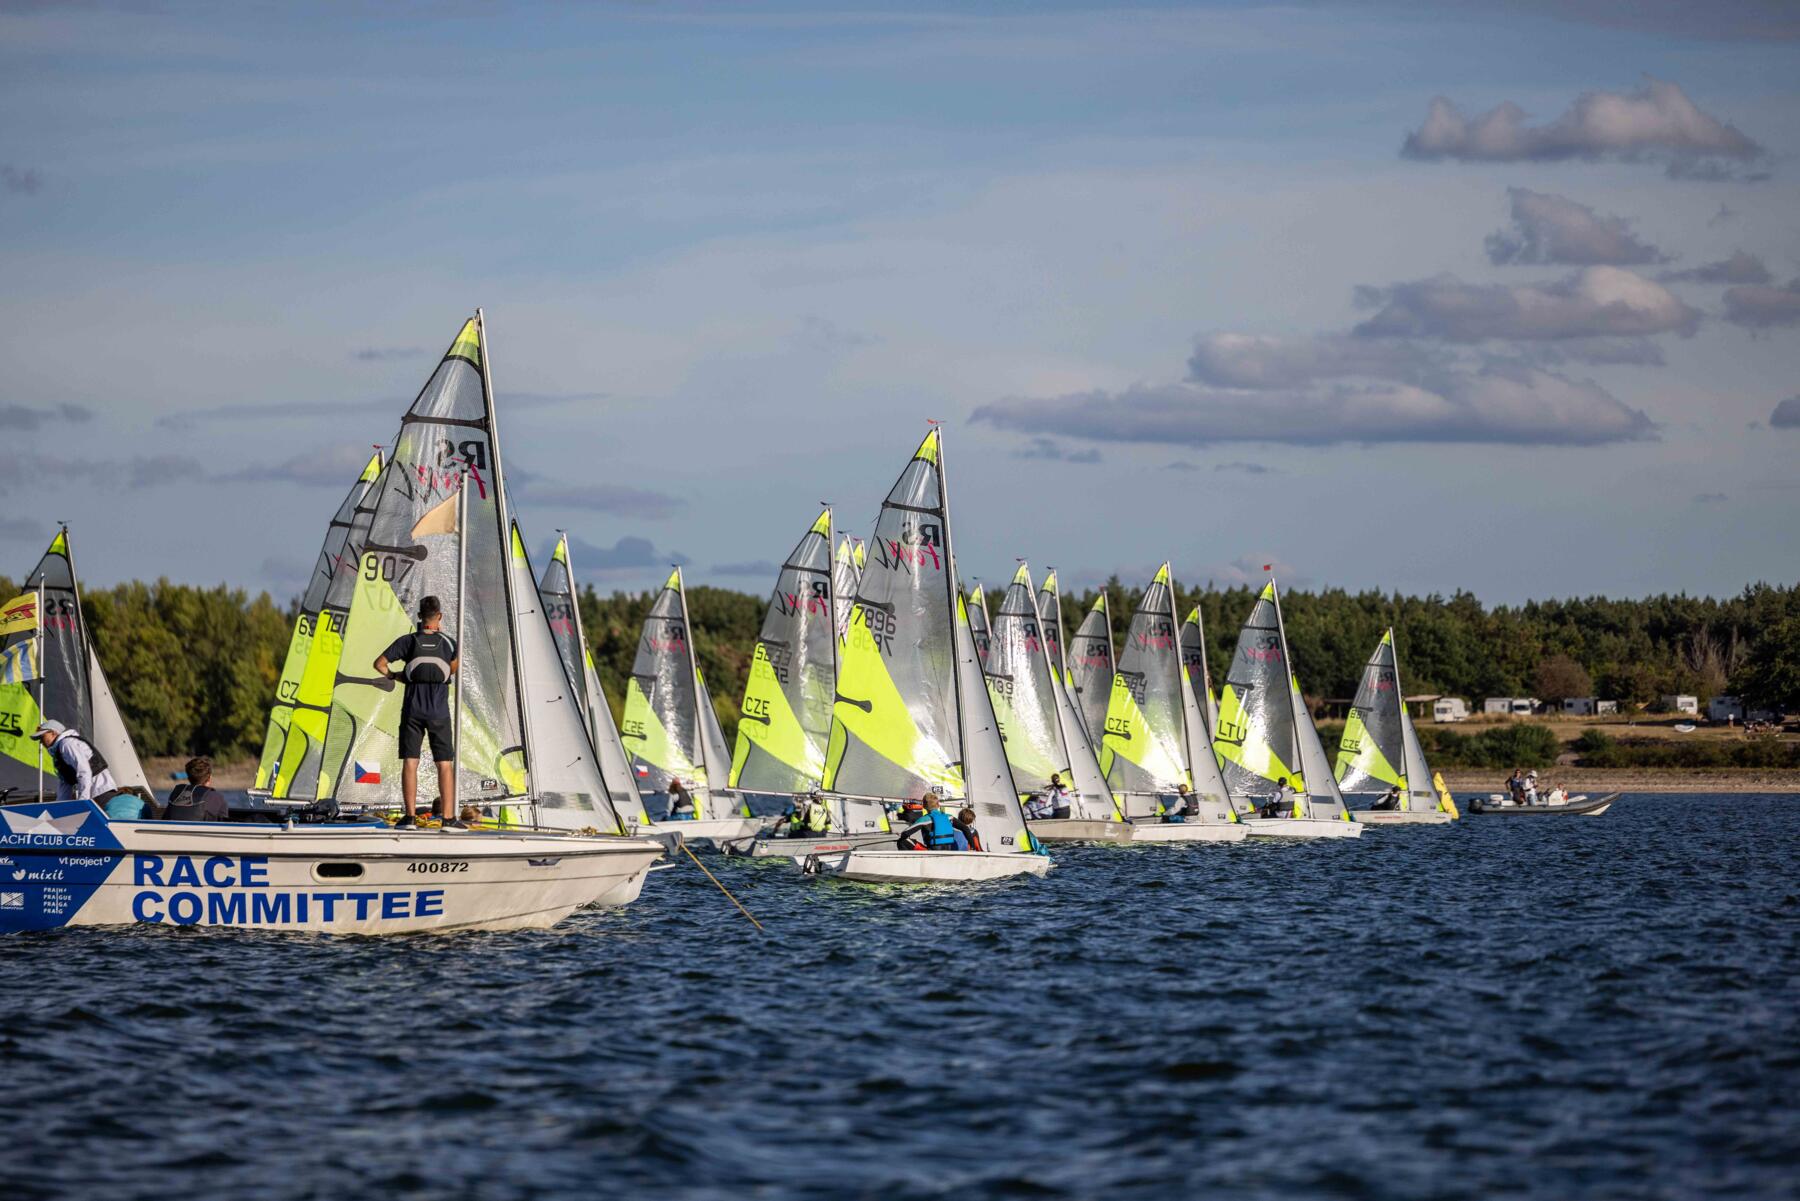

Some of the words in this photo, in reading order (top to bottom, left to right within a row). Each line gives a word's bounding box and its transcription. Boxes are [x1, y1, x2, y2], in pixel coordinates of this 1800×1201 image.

[365, 555, 415, 583] 907
[855, 605, 897, 635] 7896
[745, 696, 770, 717] CZE
[624, 720, 645, 734] CZE
[1107, 717, 1130, 733] CZE
[1218, 720, 1247, 742] LTU
[1342, 738, 1361, 750] CZE
[0, 833, 32, 845] ACHT
[34, 835, 63, 846] CLUB
[66, 836, 96, 847] CERE
[69, 856, 104, 868] project
[407, 862, 470, 874] 400872
[28, 869, 65, 880] mixit
[133, 855, 270, 888] RACE
[132, 890, 446, 926] COMMITTEE
